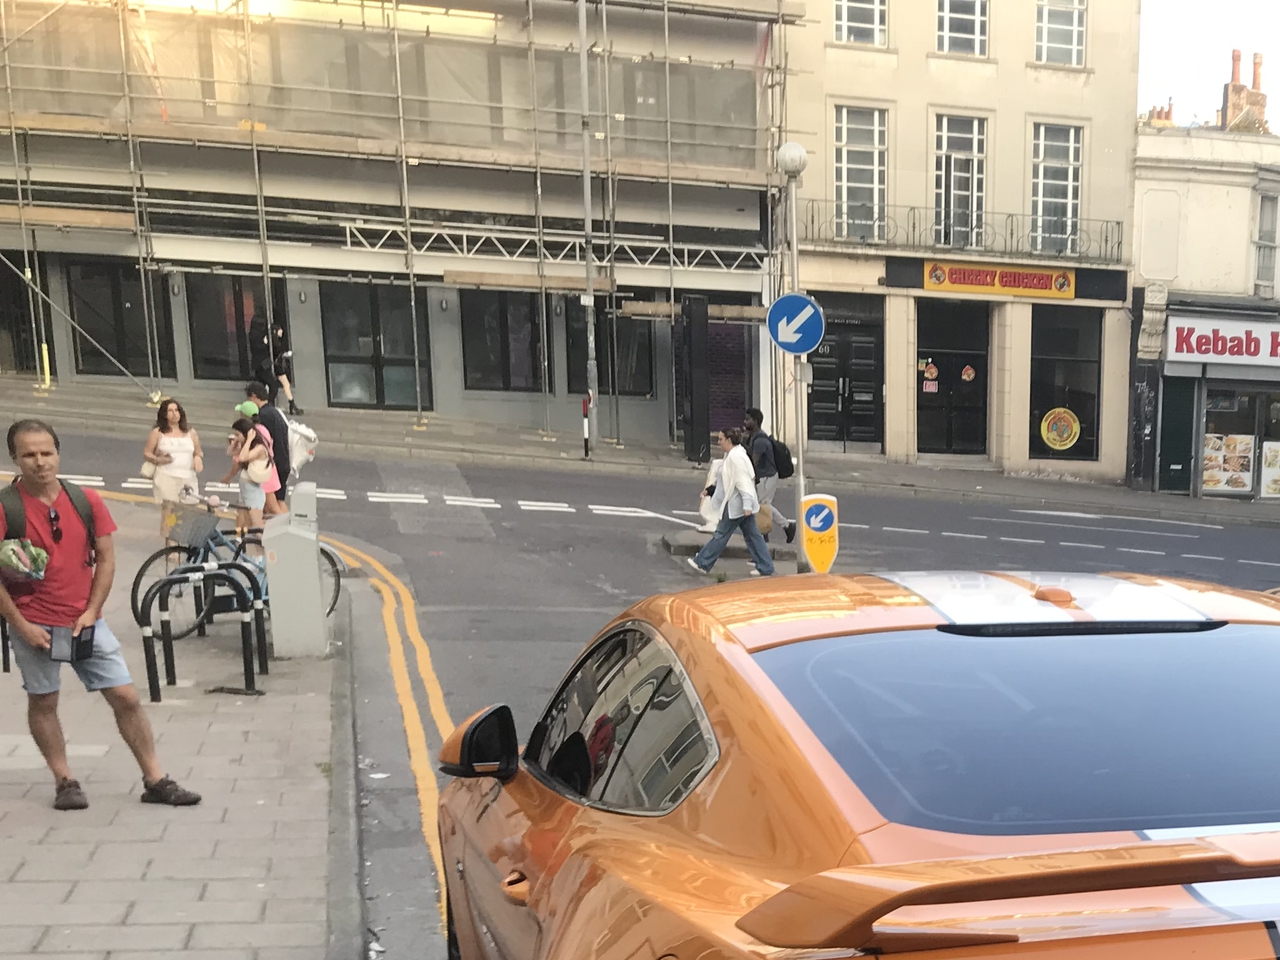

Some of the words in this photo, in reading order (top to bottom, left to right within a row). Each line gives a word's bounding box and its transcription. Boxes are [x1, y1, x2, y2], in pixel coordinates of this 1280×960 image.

[947, 267, 997, 287] CHEEKY
[998, 270, 1053, 290] CHICKEN
[818, 344, 830, 354] 60
[1174, 325, 1261, 357] Kebab
